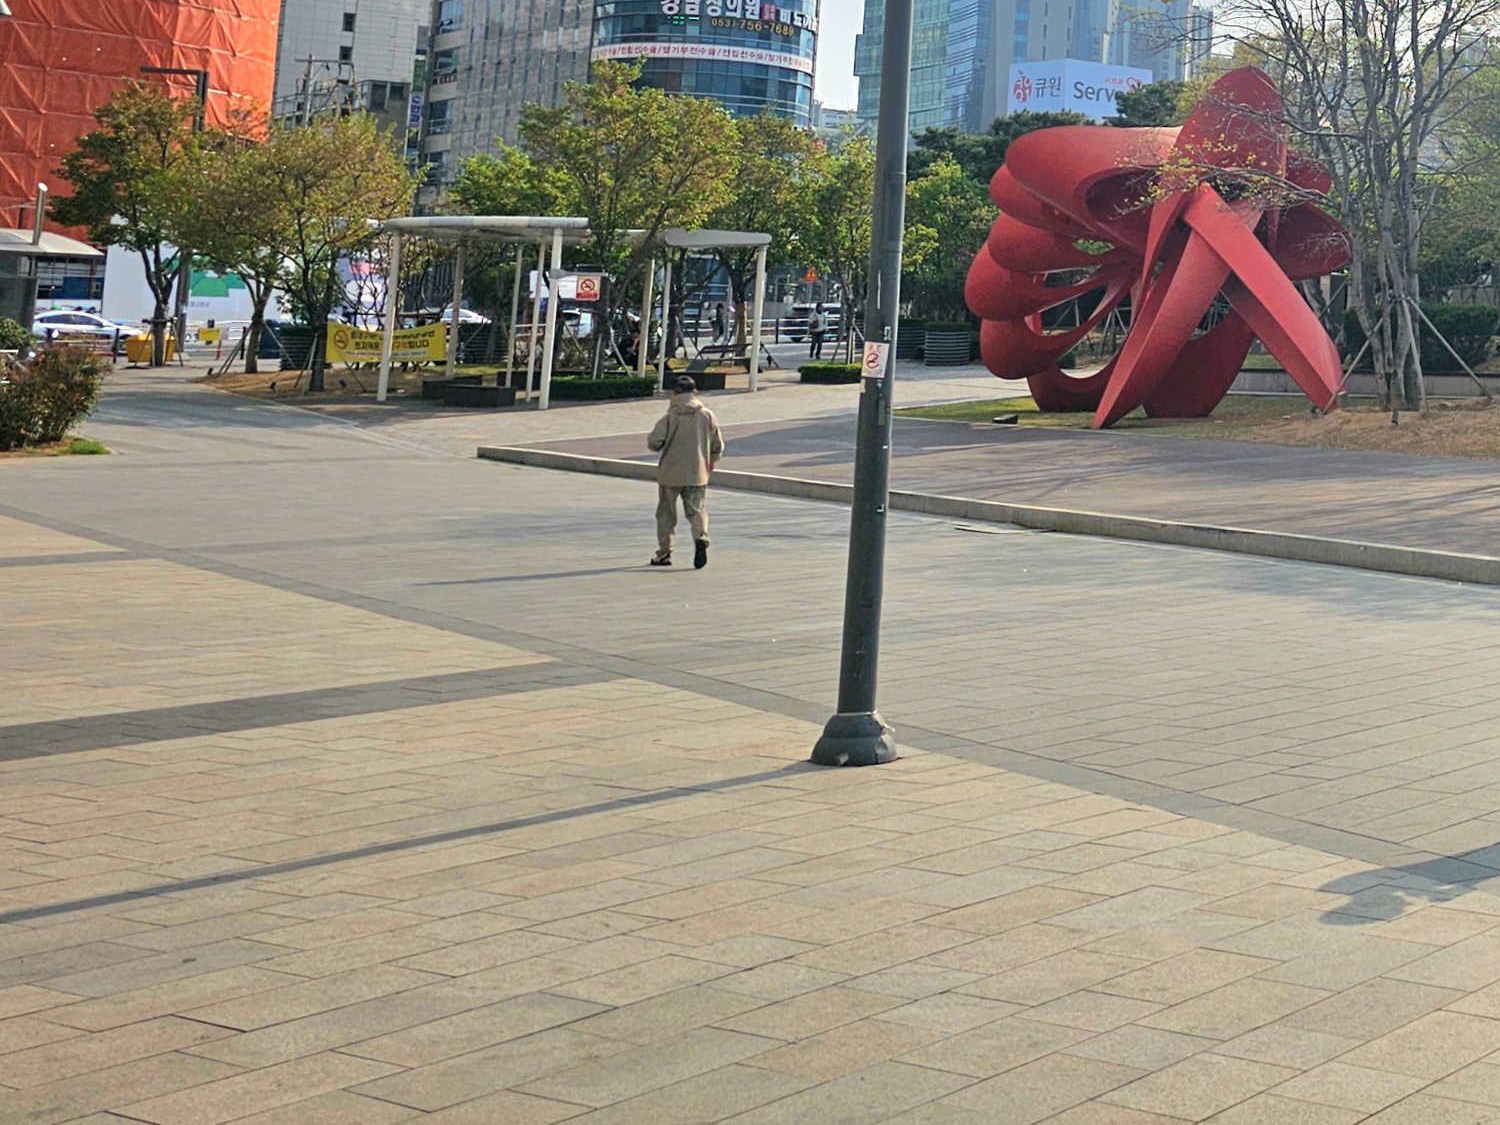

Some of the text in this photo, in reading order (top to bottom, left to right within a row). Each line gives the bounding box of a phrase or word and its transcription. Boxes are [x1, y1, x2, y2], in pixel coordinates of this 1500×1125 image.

[711, 18, 736, 28] 053)
[739, 19, 795, 37] 756-7689
[1034, 76, 1061, 98] 큐원
